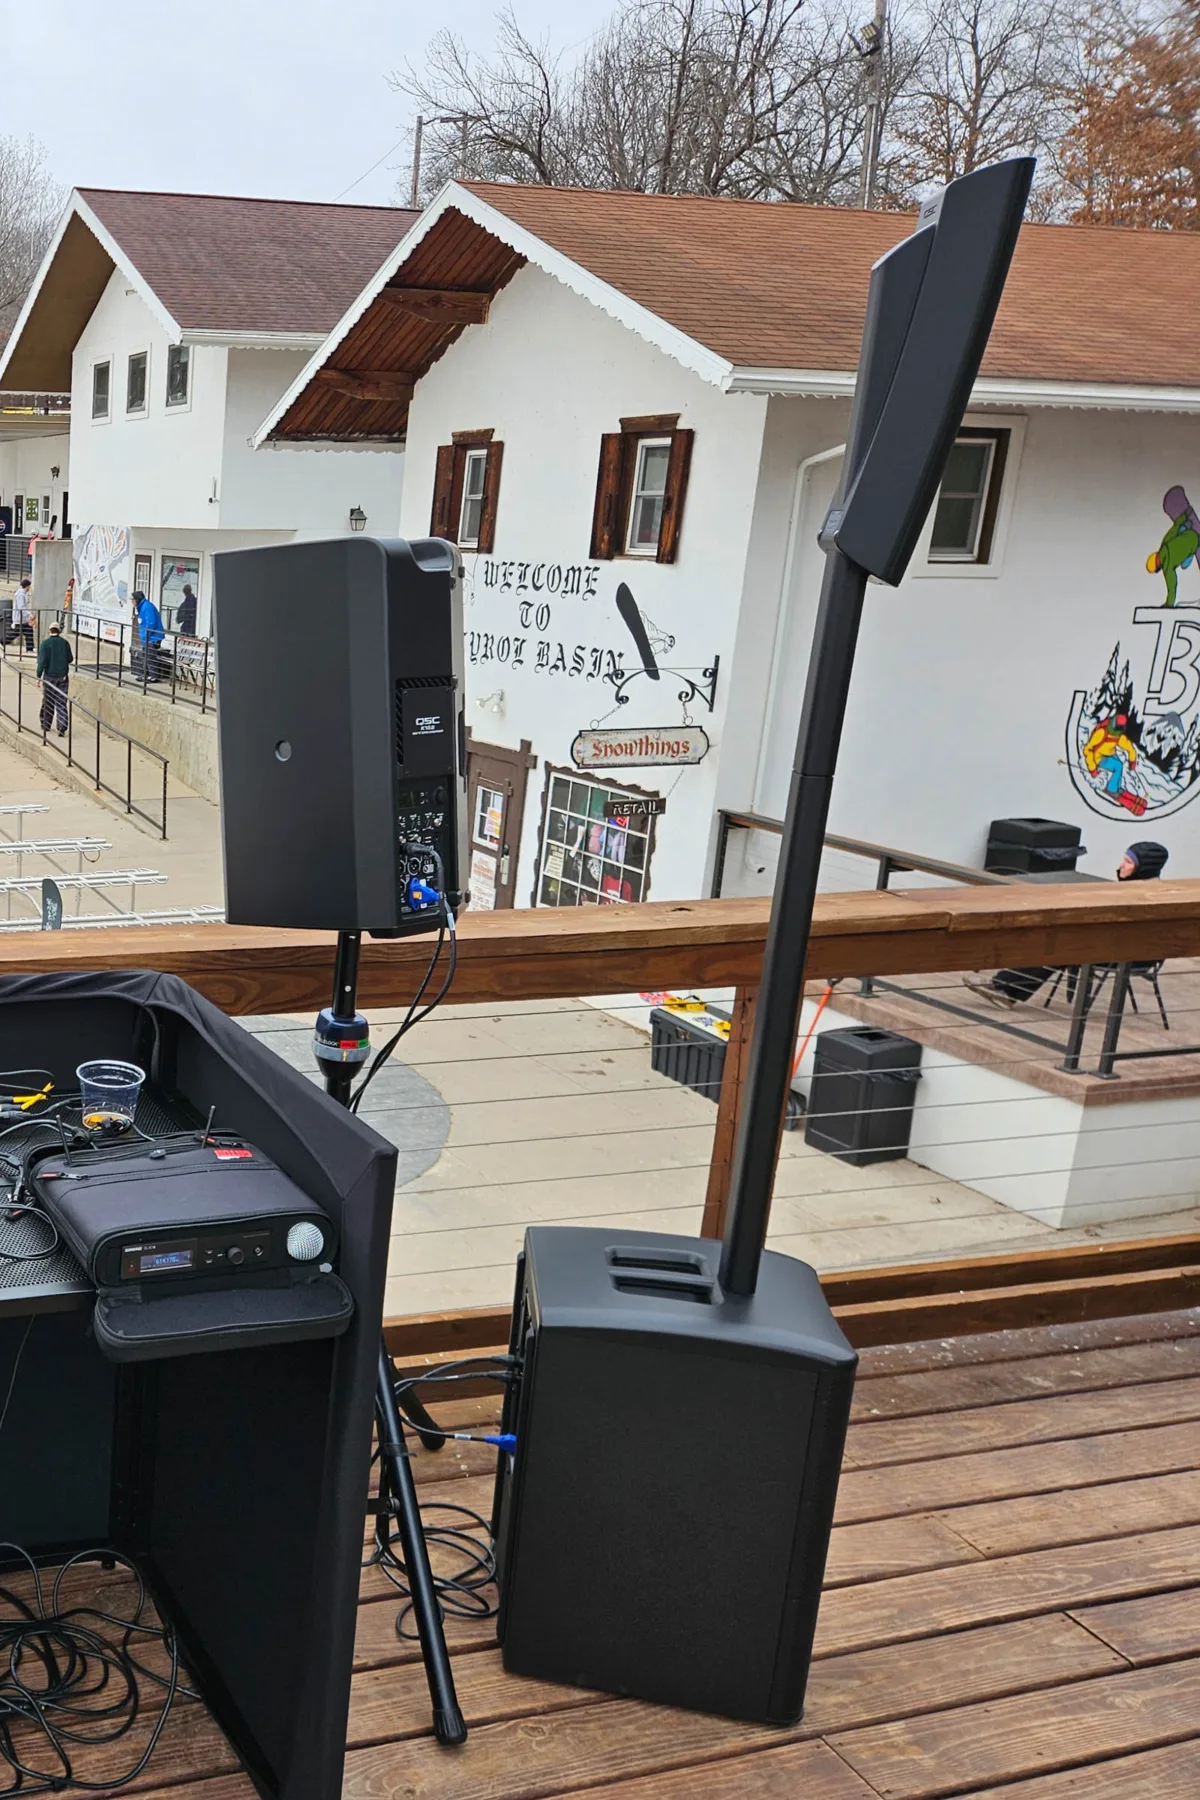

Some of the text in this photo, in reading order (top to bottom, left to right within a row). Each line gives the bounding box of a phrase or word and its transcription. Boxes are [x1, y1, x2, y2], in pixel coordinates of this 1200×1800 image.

[484, 560, 601, 601] WELCOME
[518, 600, 551, 631] TO
[464, 631, 625, 684] YROL BASIN
[415, 716, 440, 726] QSC
[591, 735, 690, 758] Snowthings
[613, 800, 661, 816] RETAIL
